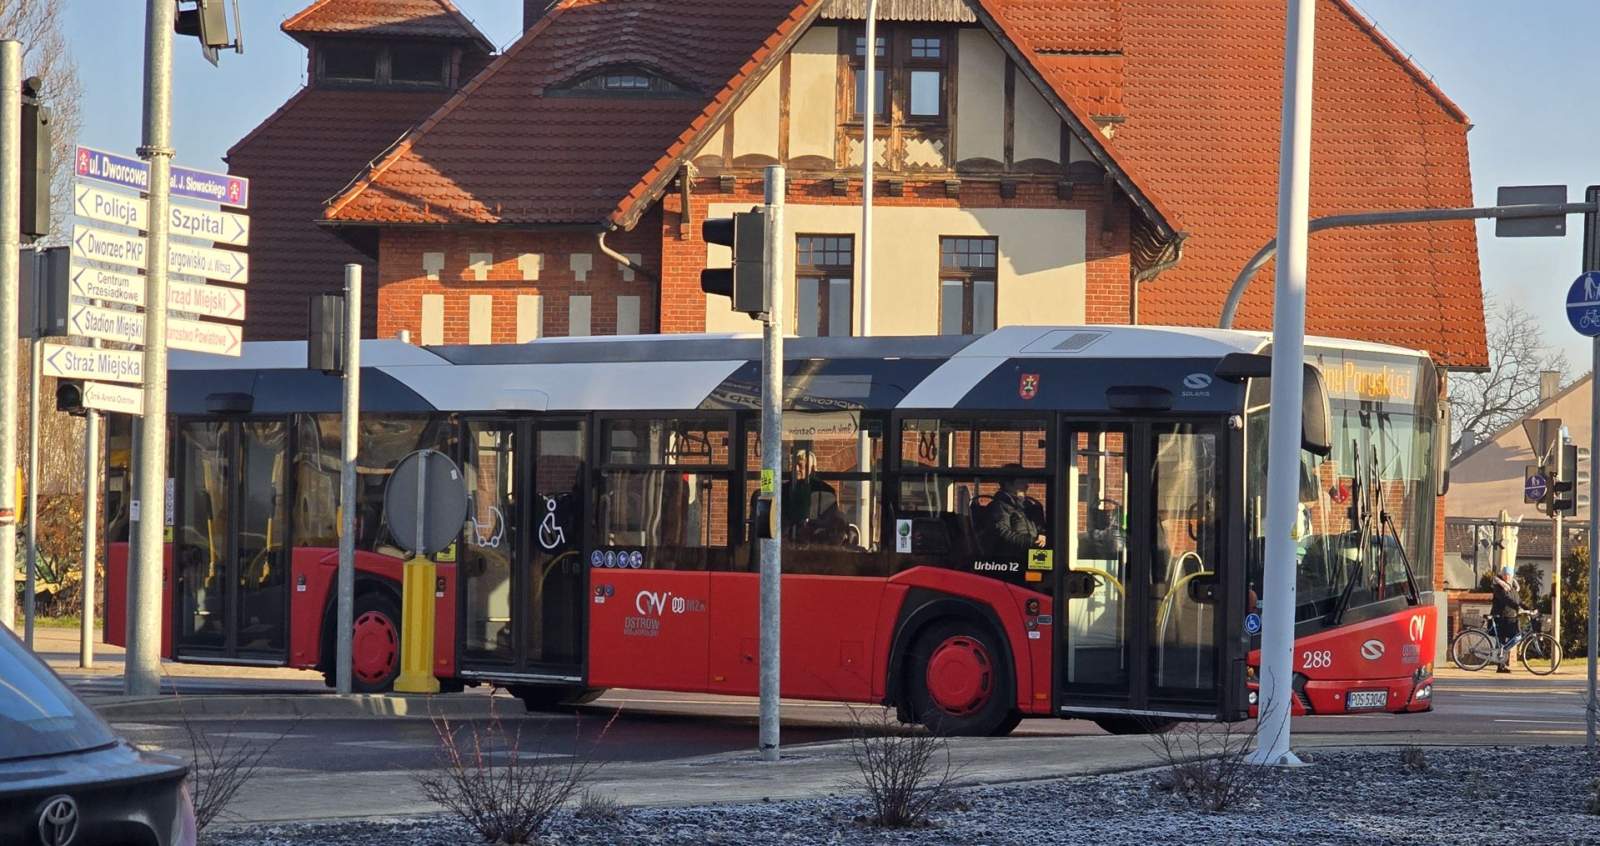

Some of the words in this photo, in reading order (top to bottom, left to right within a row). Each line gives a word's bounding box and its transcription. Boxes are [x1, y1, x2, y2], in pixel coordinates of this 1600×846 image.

[89, 155, 100, 175] ul.
[102, 156, 147, 186] Dworcowa
[178, 176, 186, 190] J.
[95, 195, 137, 224] Policja
[172, 208, 224, 235] Szpital
[88, 234, 125, 259] Dworzec
[126, 241, 143, 261] PKP
[87, 283, 139, 301] Przesiadkowe
[97, 272, 129, 287] Centrum
[194, 288, 226, 313] Miejski
[85, 310, 115, 332] Stadion
[116, 315, 143, 340] Miejski
[65, 351, 95, 372] Straż
[98, 355, 140, 378] Miejska
[1344, 361, 1411, 399] Paryskiej
[974, 561, 1008, 571] Urbino
[1009, 562, 1020, 572] 12
[1302, 650, 1332, 669] 288
[1351, 693, 1364, 706] POS
[1365, 693, 1386, 706] 53042
